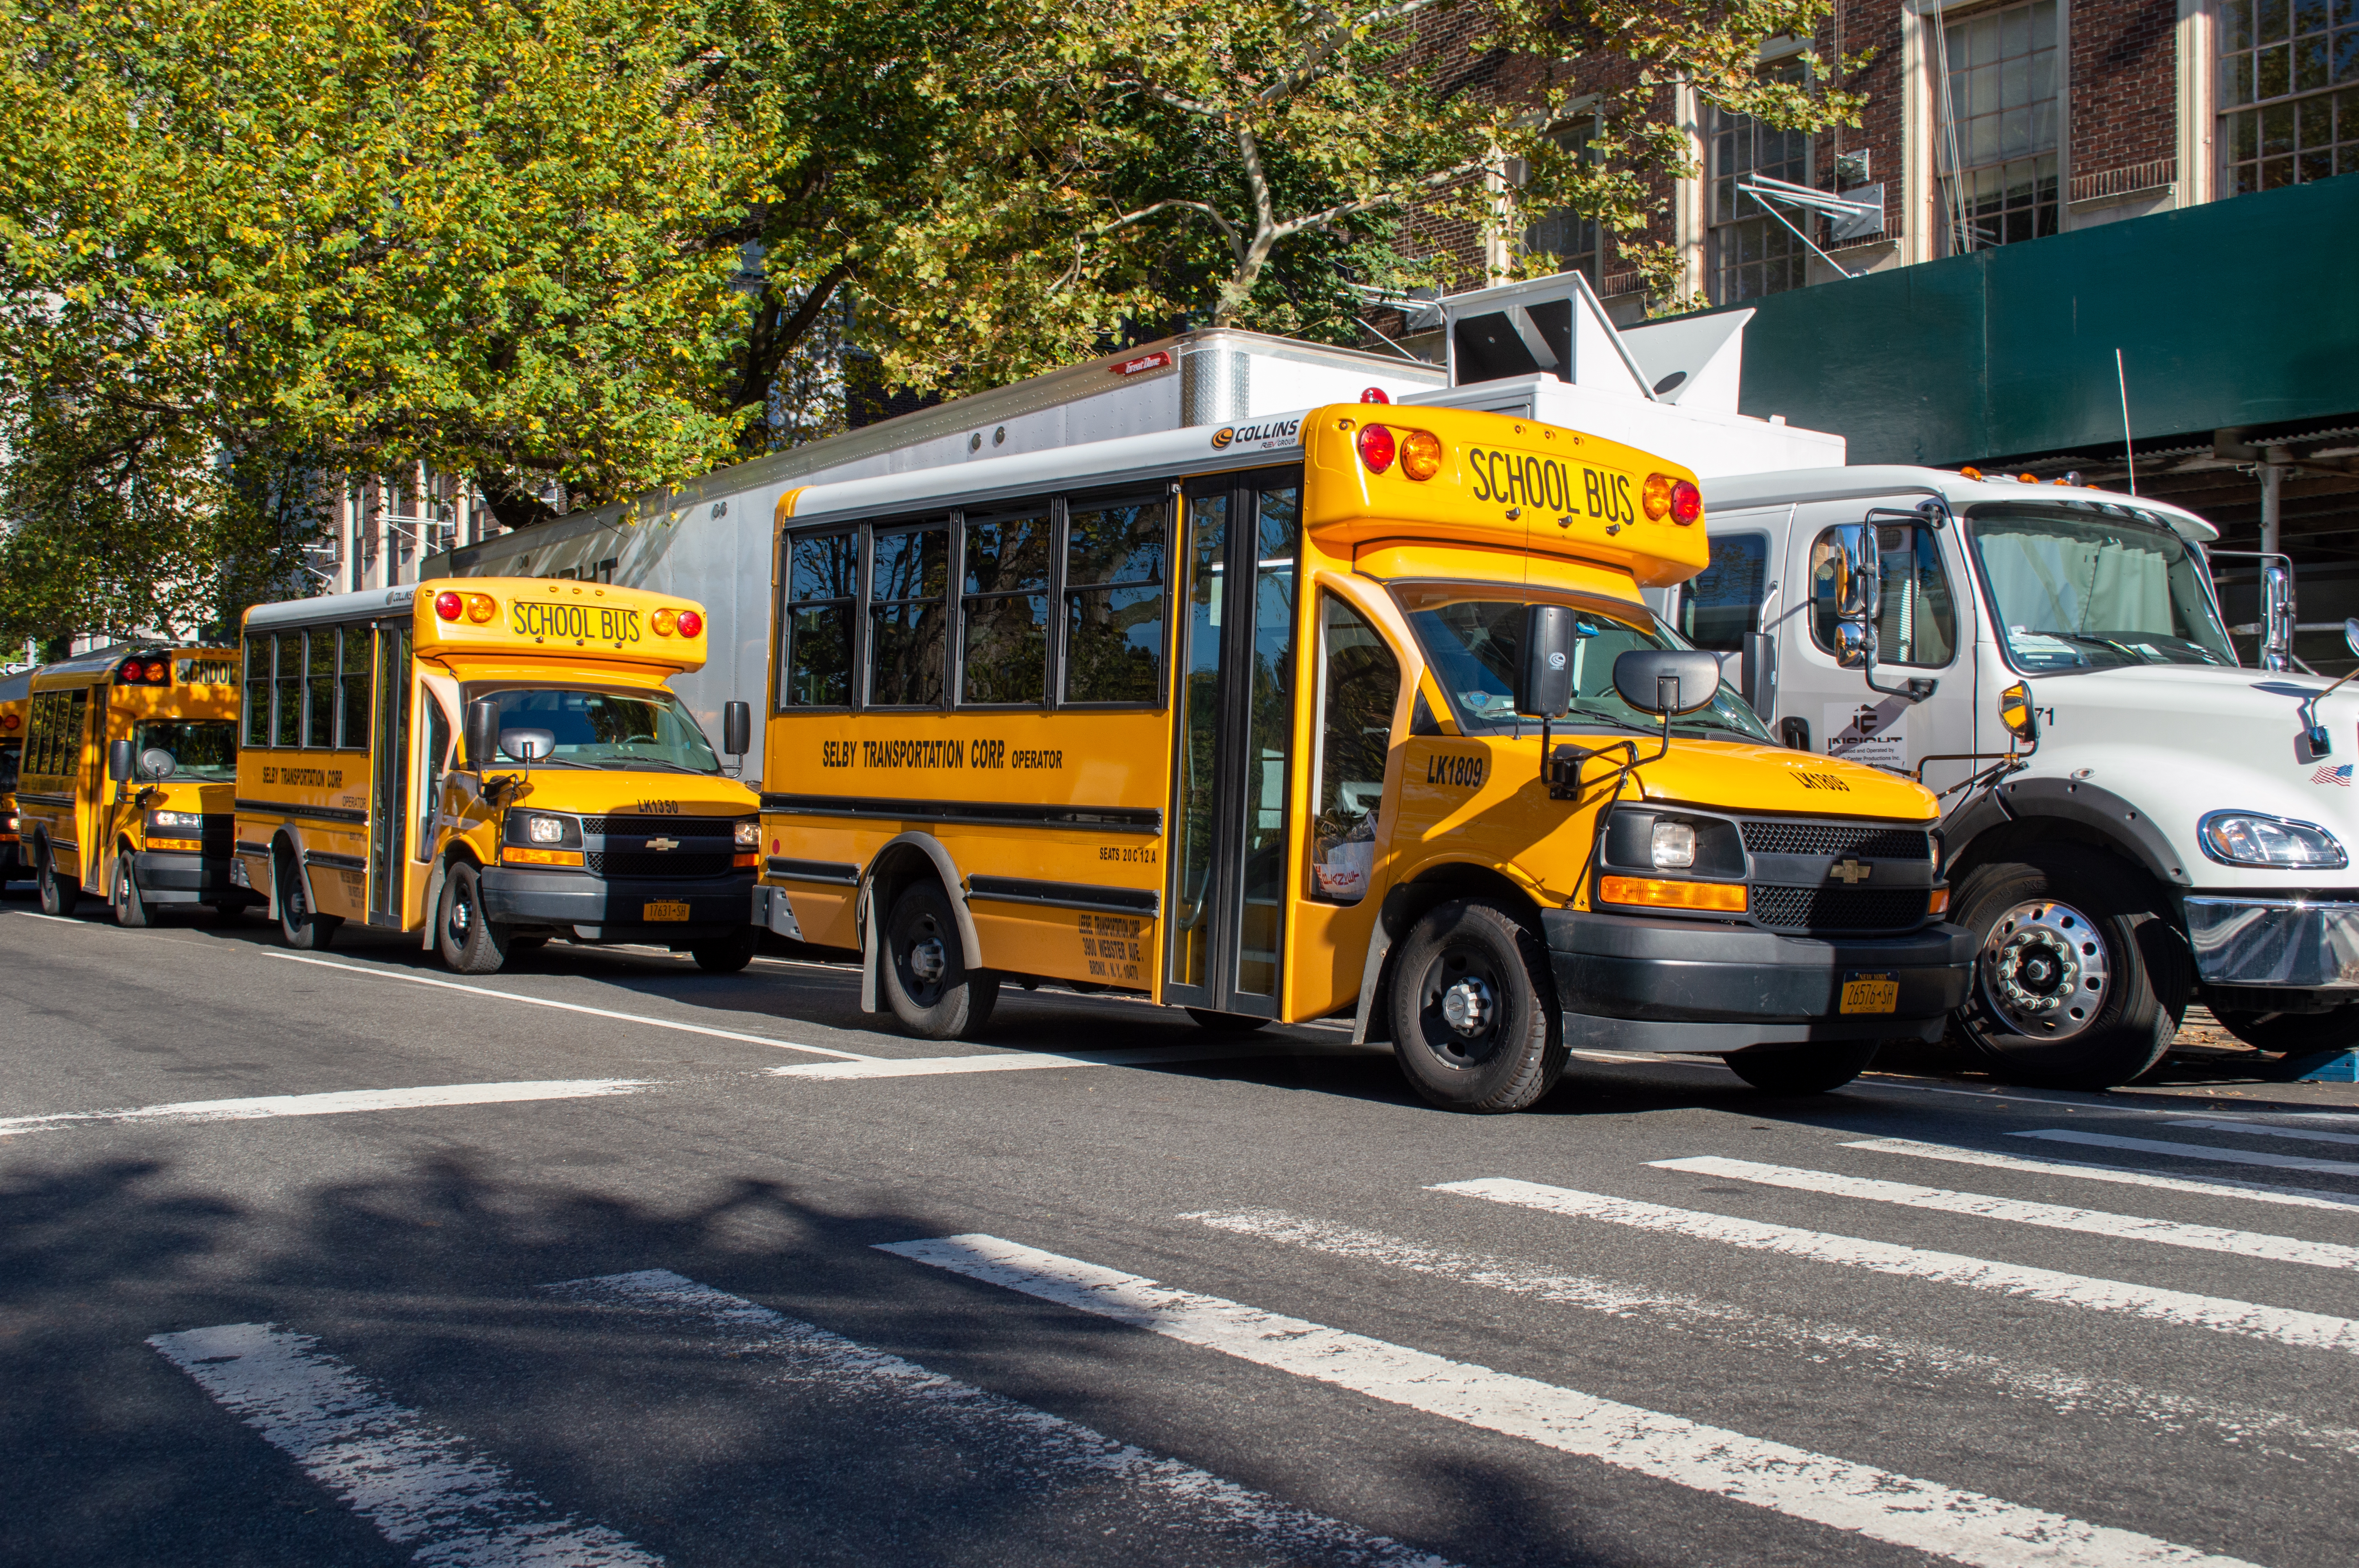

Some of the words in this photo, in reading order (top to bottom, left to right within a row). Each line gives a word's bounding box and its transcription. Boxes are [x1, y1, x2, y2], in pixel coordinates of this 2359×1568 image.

[1125, 361, 1144, 374] Great
[1143, 356, 1161, 369] Dane
[1235, 419, 1299, 443] COLLINS
[1261, 437, 1281, 449] REV
[1278, 438, 1296, 446] GROUP
[1470, 448, 1580, 514] SCHOOL
[1583, 468, 1634, 525] BUS
[393, 590, 414, 602] COLLINS
[514, 604, 595, 638] SCHOOL
[601, 610, 640, 642] BUS
[179, 660, 237, 684] SCHOOL
[823, 740, 857, 767] SELBY
[863, 740, 964, 768] TRANSPORTATION
[971, 739, 1005, 768] CORP.
[1012, 750, 1062, 769] OPERATOR
[263, 766, 279, 784] SELBY
[281, 768, 325, 787] TRANSPORTATION
[1427, 755, 1483, 787] LK1809
[1788, 772, 1850, 792] LK1809
[342, 795, 367, 809] OPERATOR
[637, 799, 678, 814] LK1350
[1100, 847, 1120, 861] SEATS
[650, 904, 671, 916] 17631
[1079, 914, 1093, 935] LEESEL
[1095, 916, 1129, 938] TRANSPORTATION
[1083, 937, 1097, 956] 3900
[1098, 939, 1127, 960] WEBSTER
[1124, 964, 1138, 980] 10470
[1847, 984, 1876, 1005] 26576
